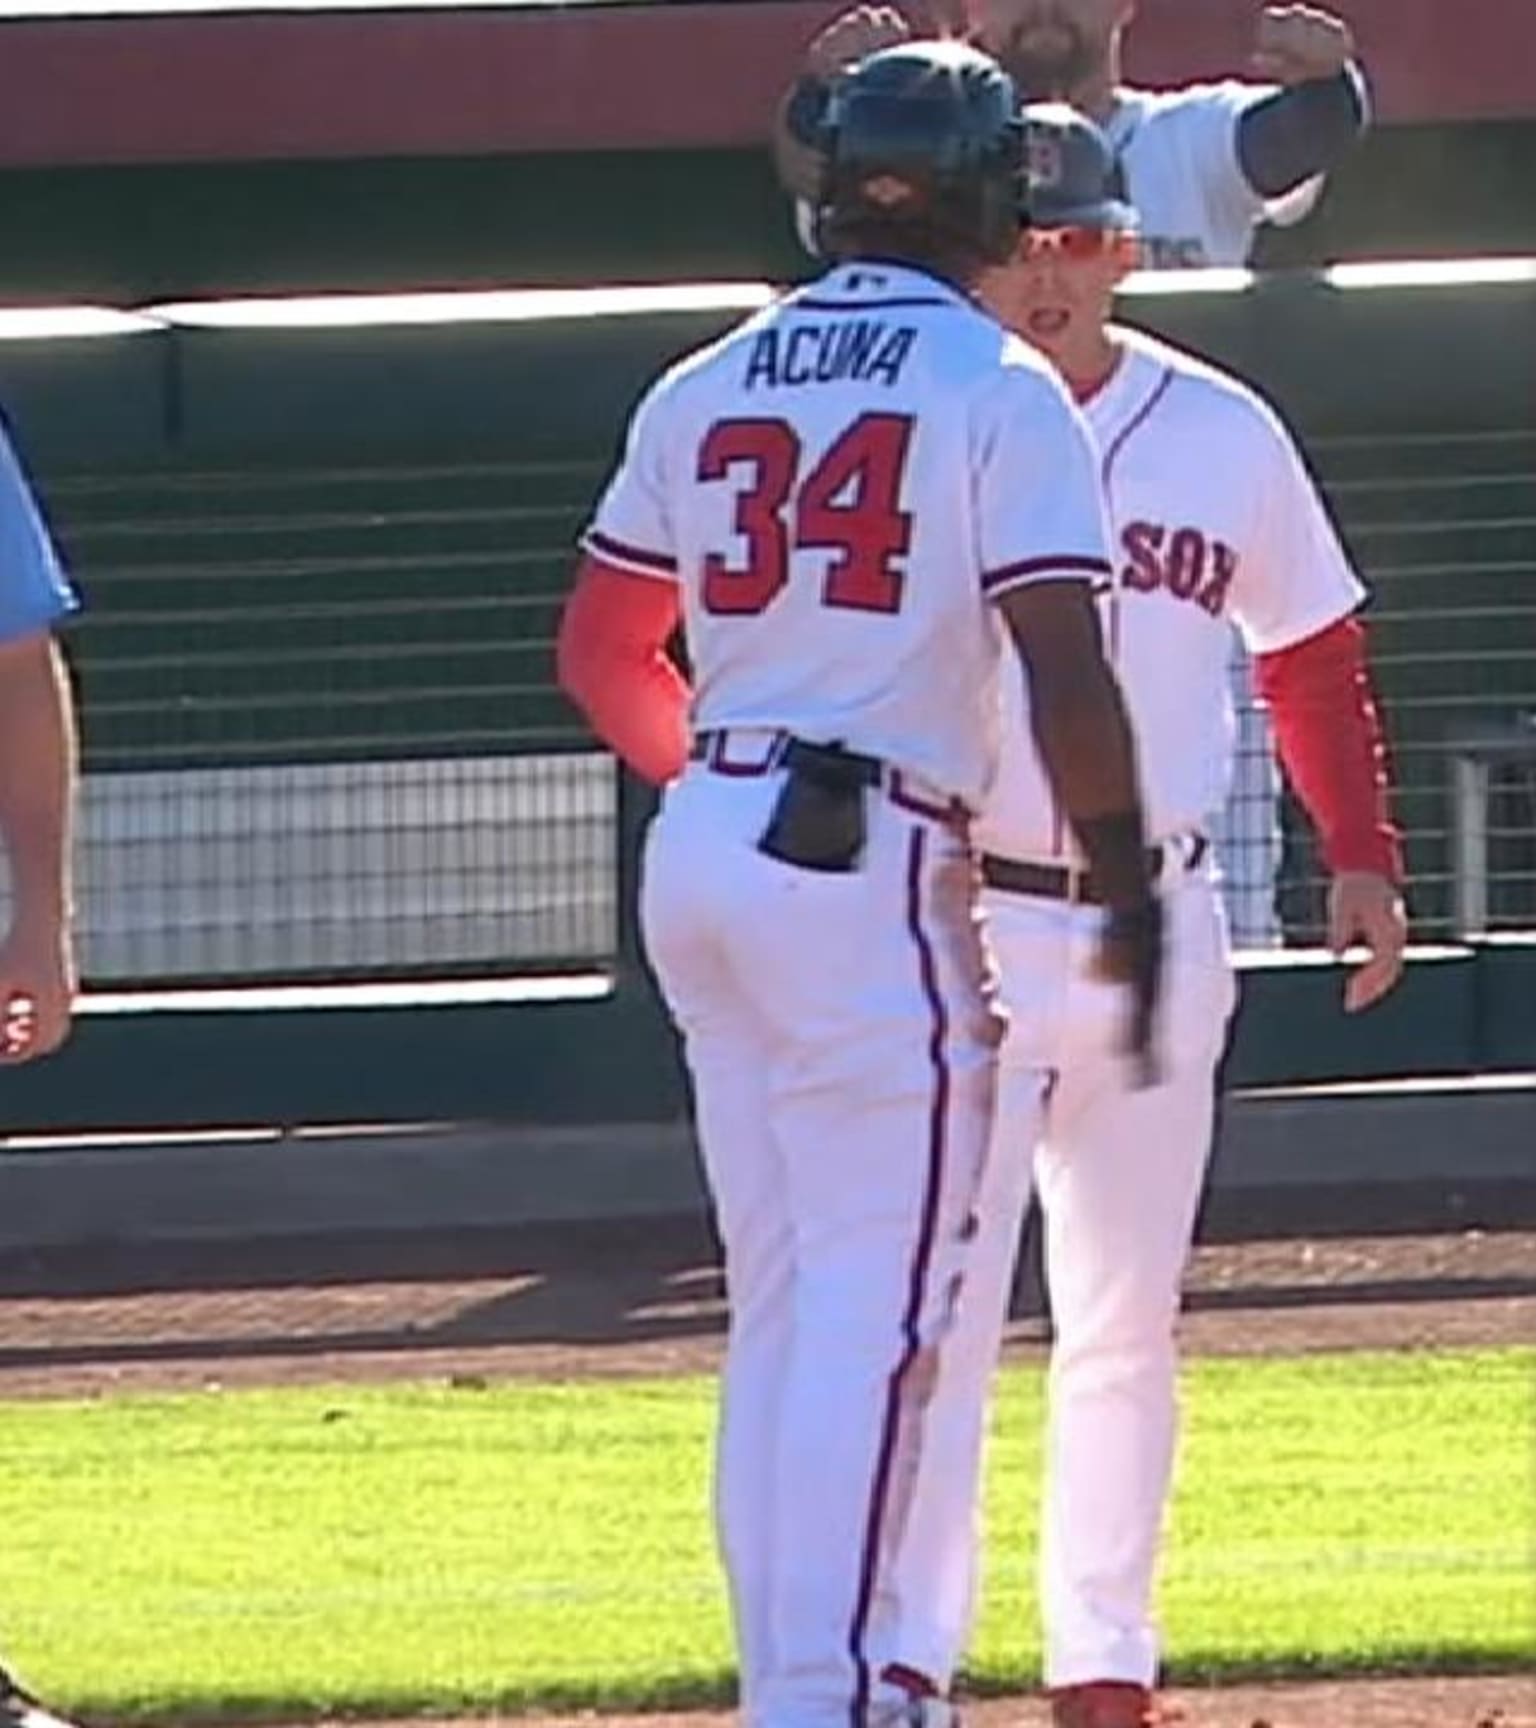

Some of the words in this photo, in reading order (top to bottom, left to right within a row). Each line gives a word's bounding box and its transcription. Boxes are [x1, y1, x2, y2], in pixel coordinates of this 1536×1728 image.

[744, 318, 918, 389] ACUNA
[696, 409, 917, 617] 34
[1121, 520, 1239, 618] SOX
